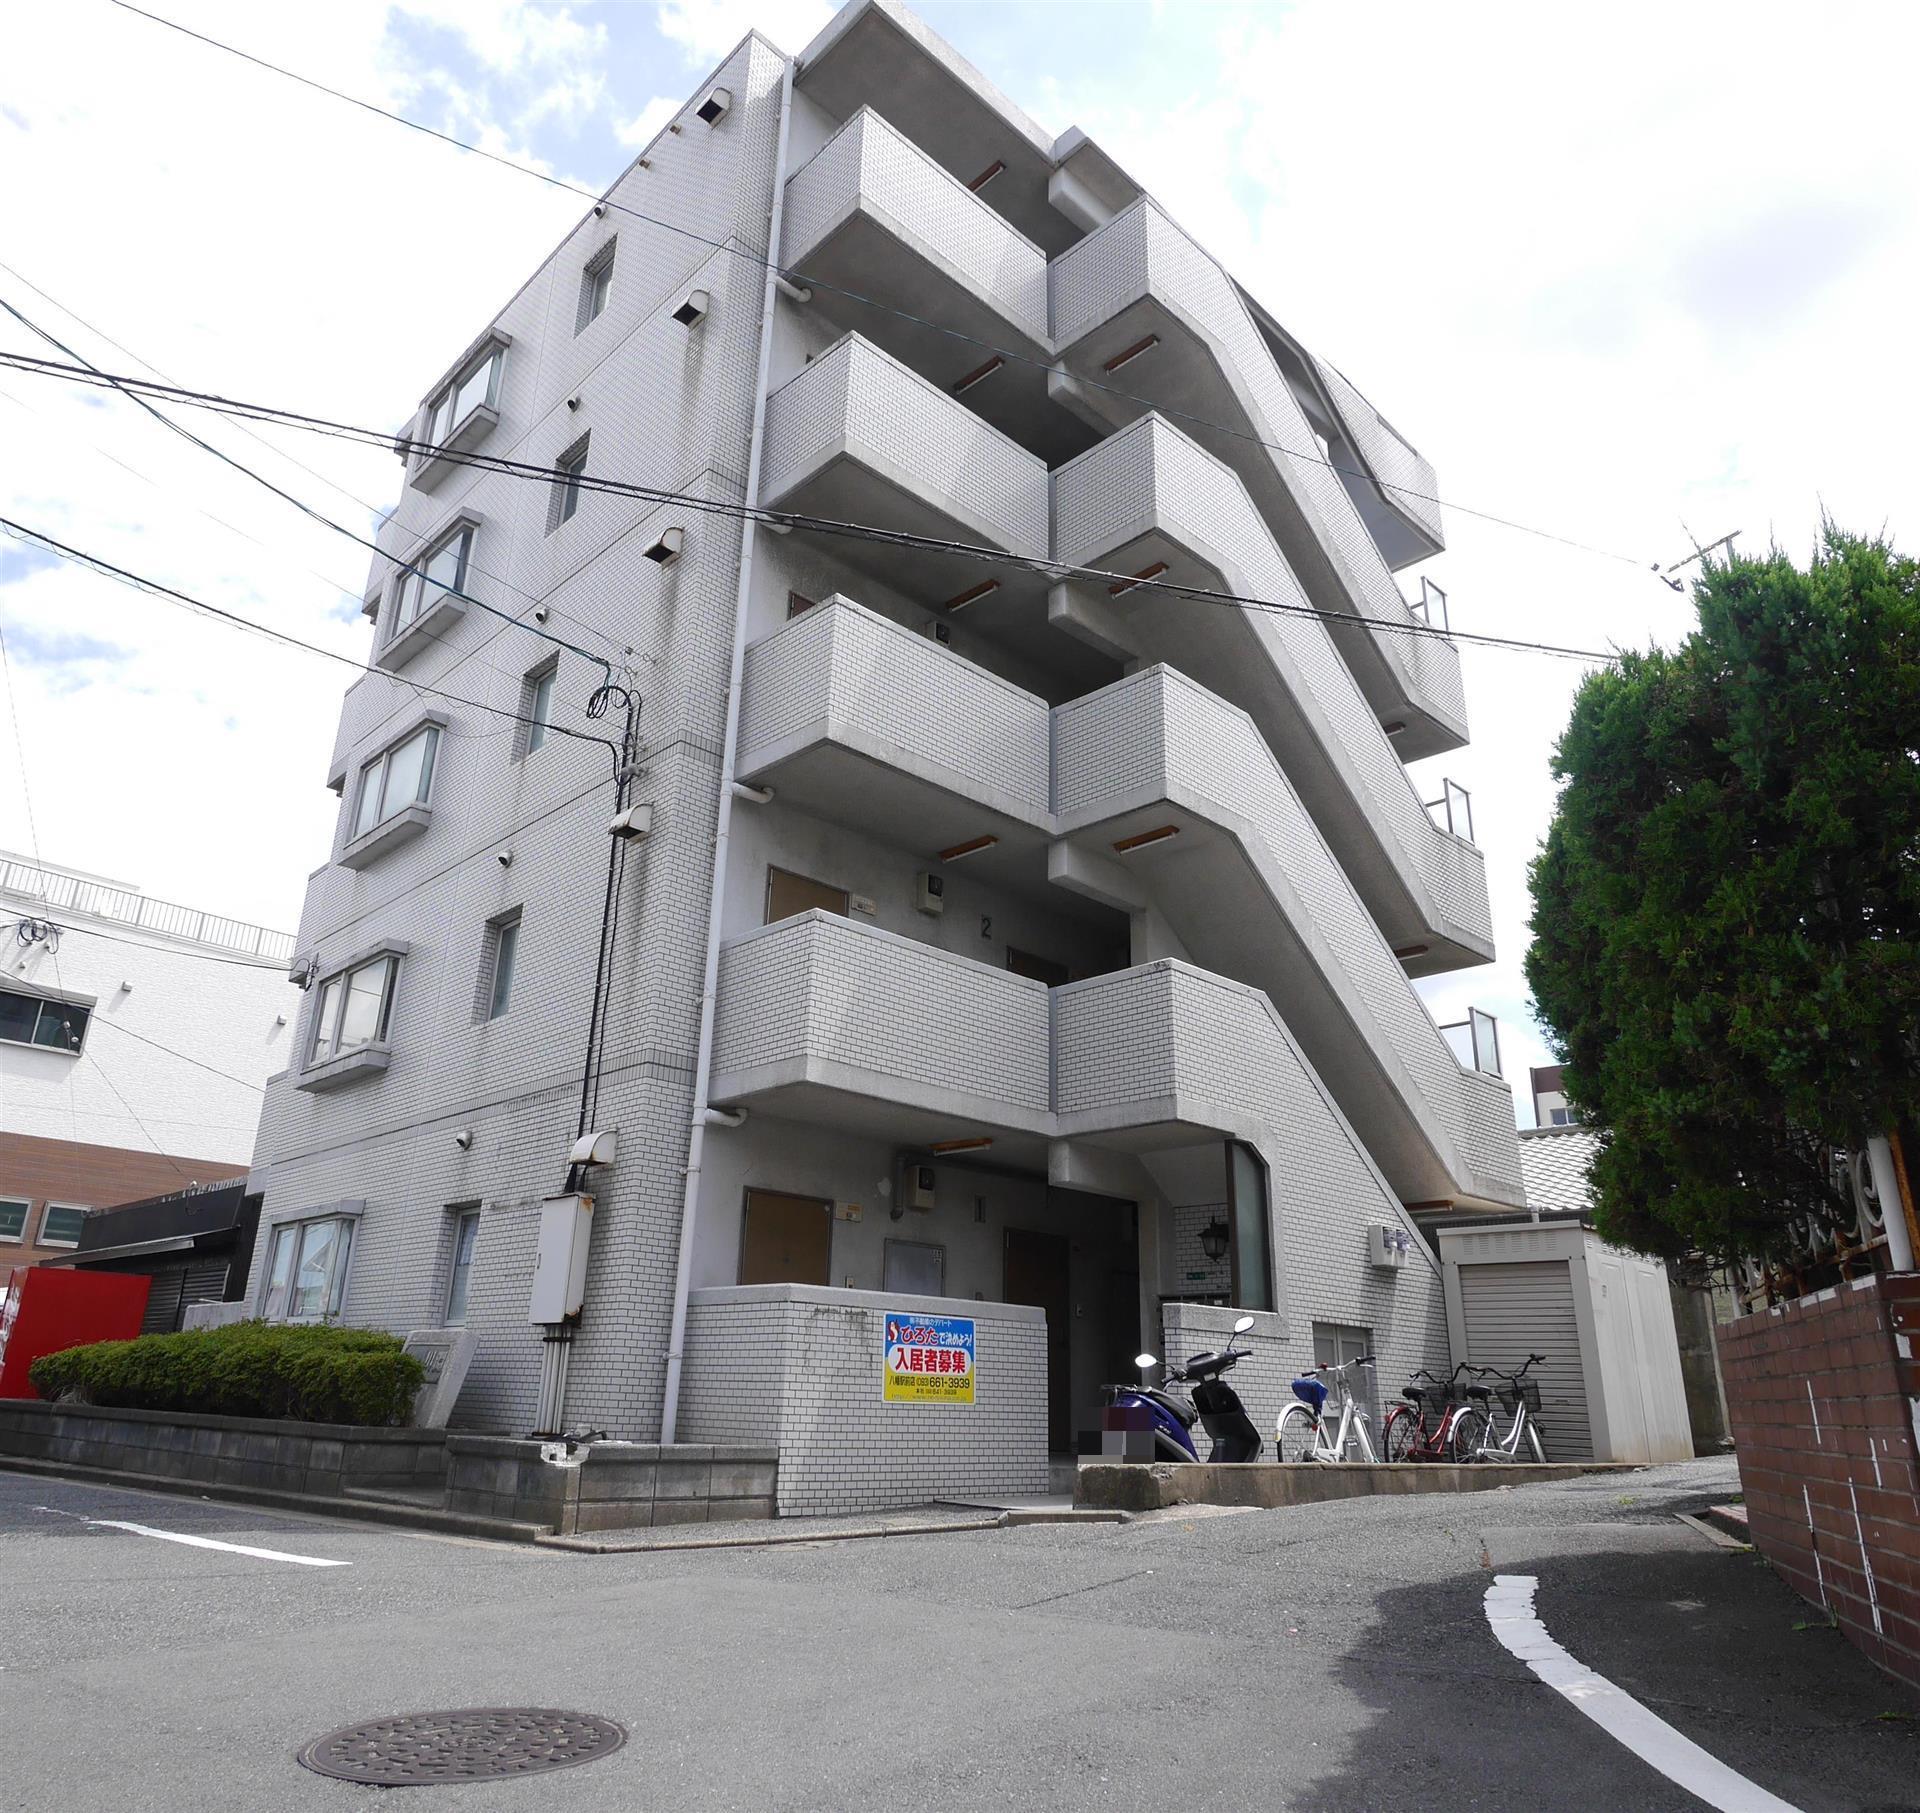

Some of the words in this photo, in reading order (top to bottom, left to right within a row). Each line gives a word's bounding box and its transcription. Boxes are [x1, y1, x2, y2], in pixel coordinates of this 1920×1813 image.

[981, 917, 992, 940] 2
[895, 1347, 966, 1374] 入居者募集
